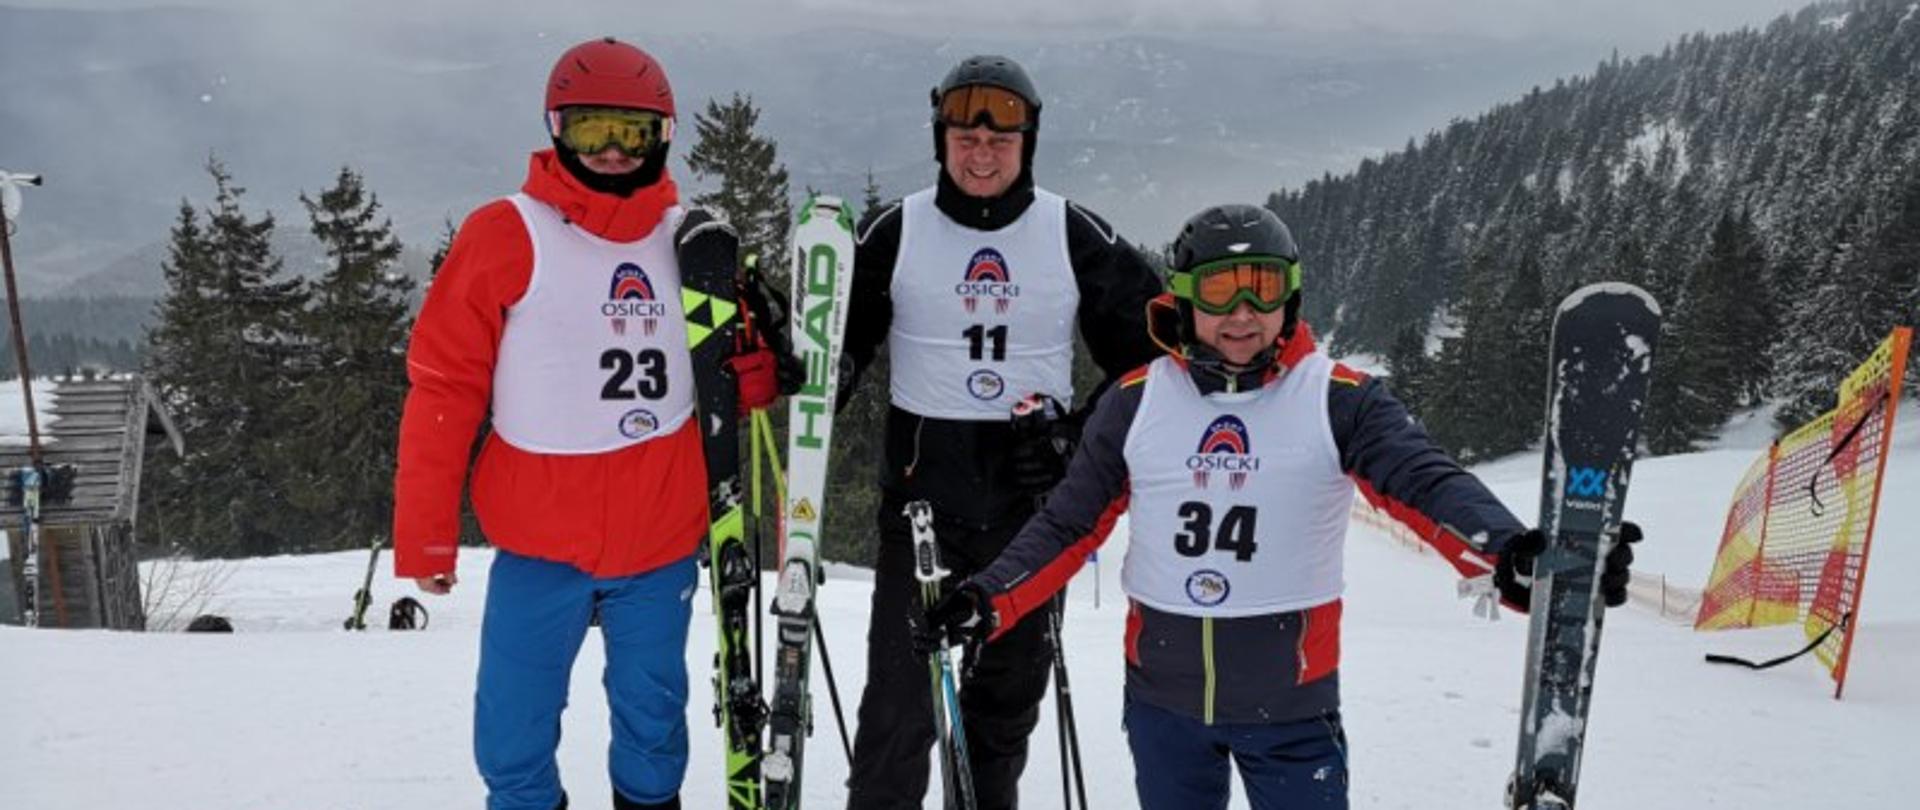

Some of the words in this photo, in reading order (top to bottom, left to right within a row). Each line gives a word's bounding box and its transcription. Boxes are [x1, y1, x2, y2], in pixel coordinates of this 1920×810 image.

[955, 283, 1020, 297] OSICKI
[601, 303, 665, 317] OSICKI
[796, 243, 838, 449] HEAD
[962, 324, 1008, 362] 11
[601, 349, 668, 400] 23
[1185, 455, 1260, 471] OSICKI
[1174, 501, 1257, 562] 34
